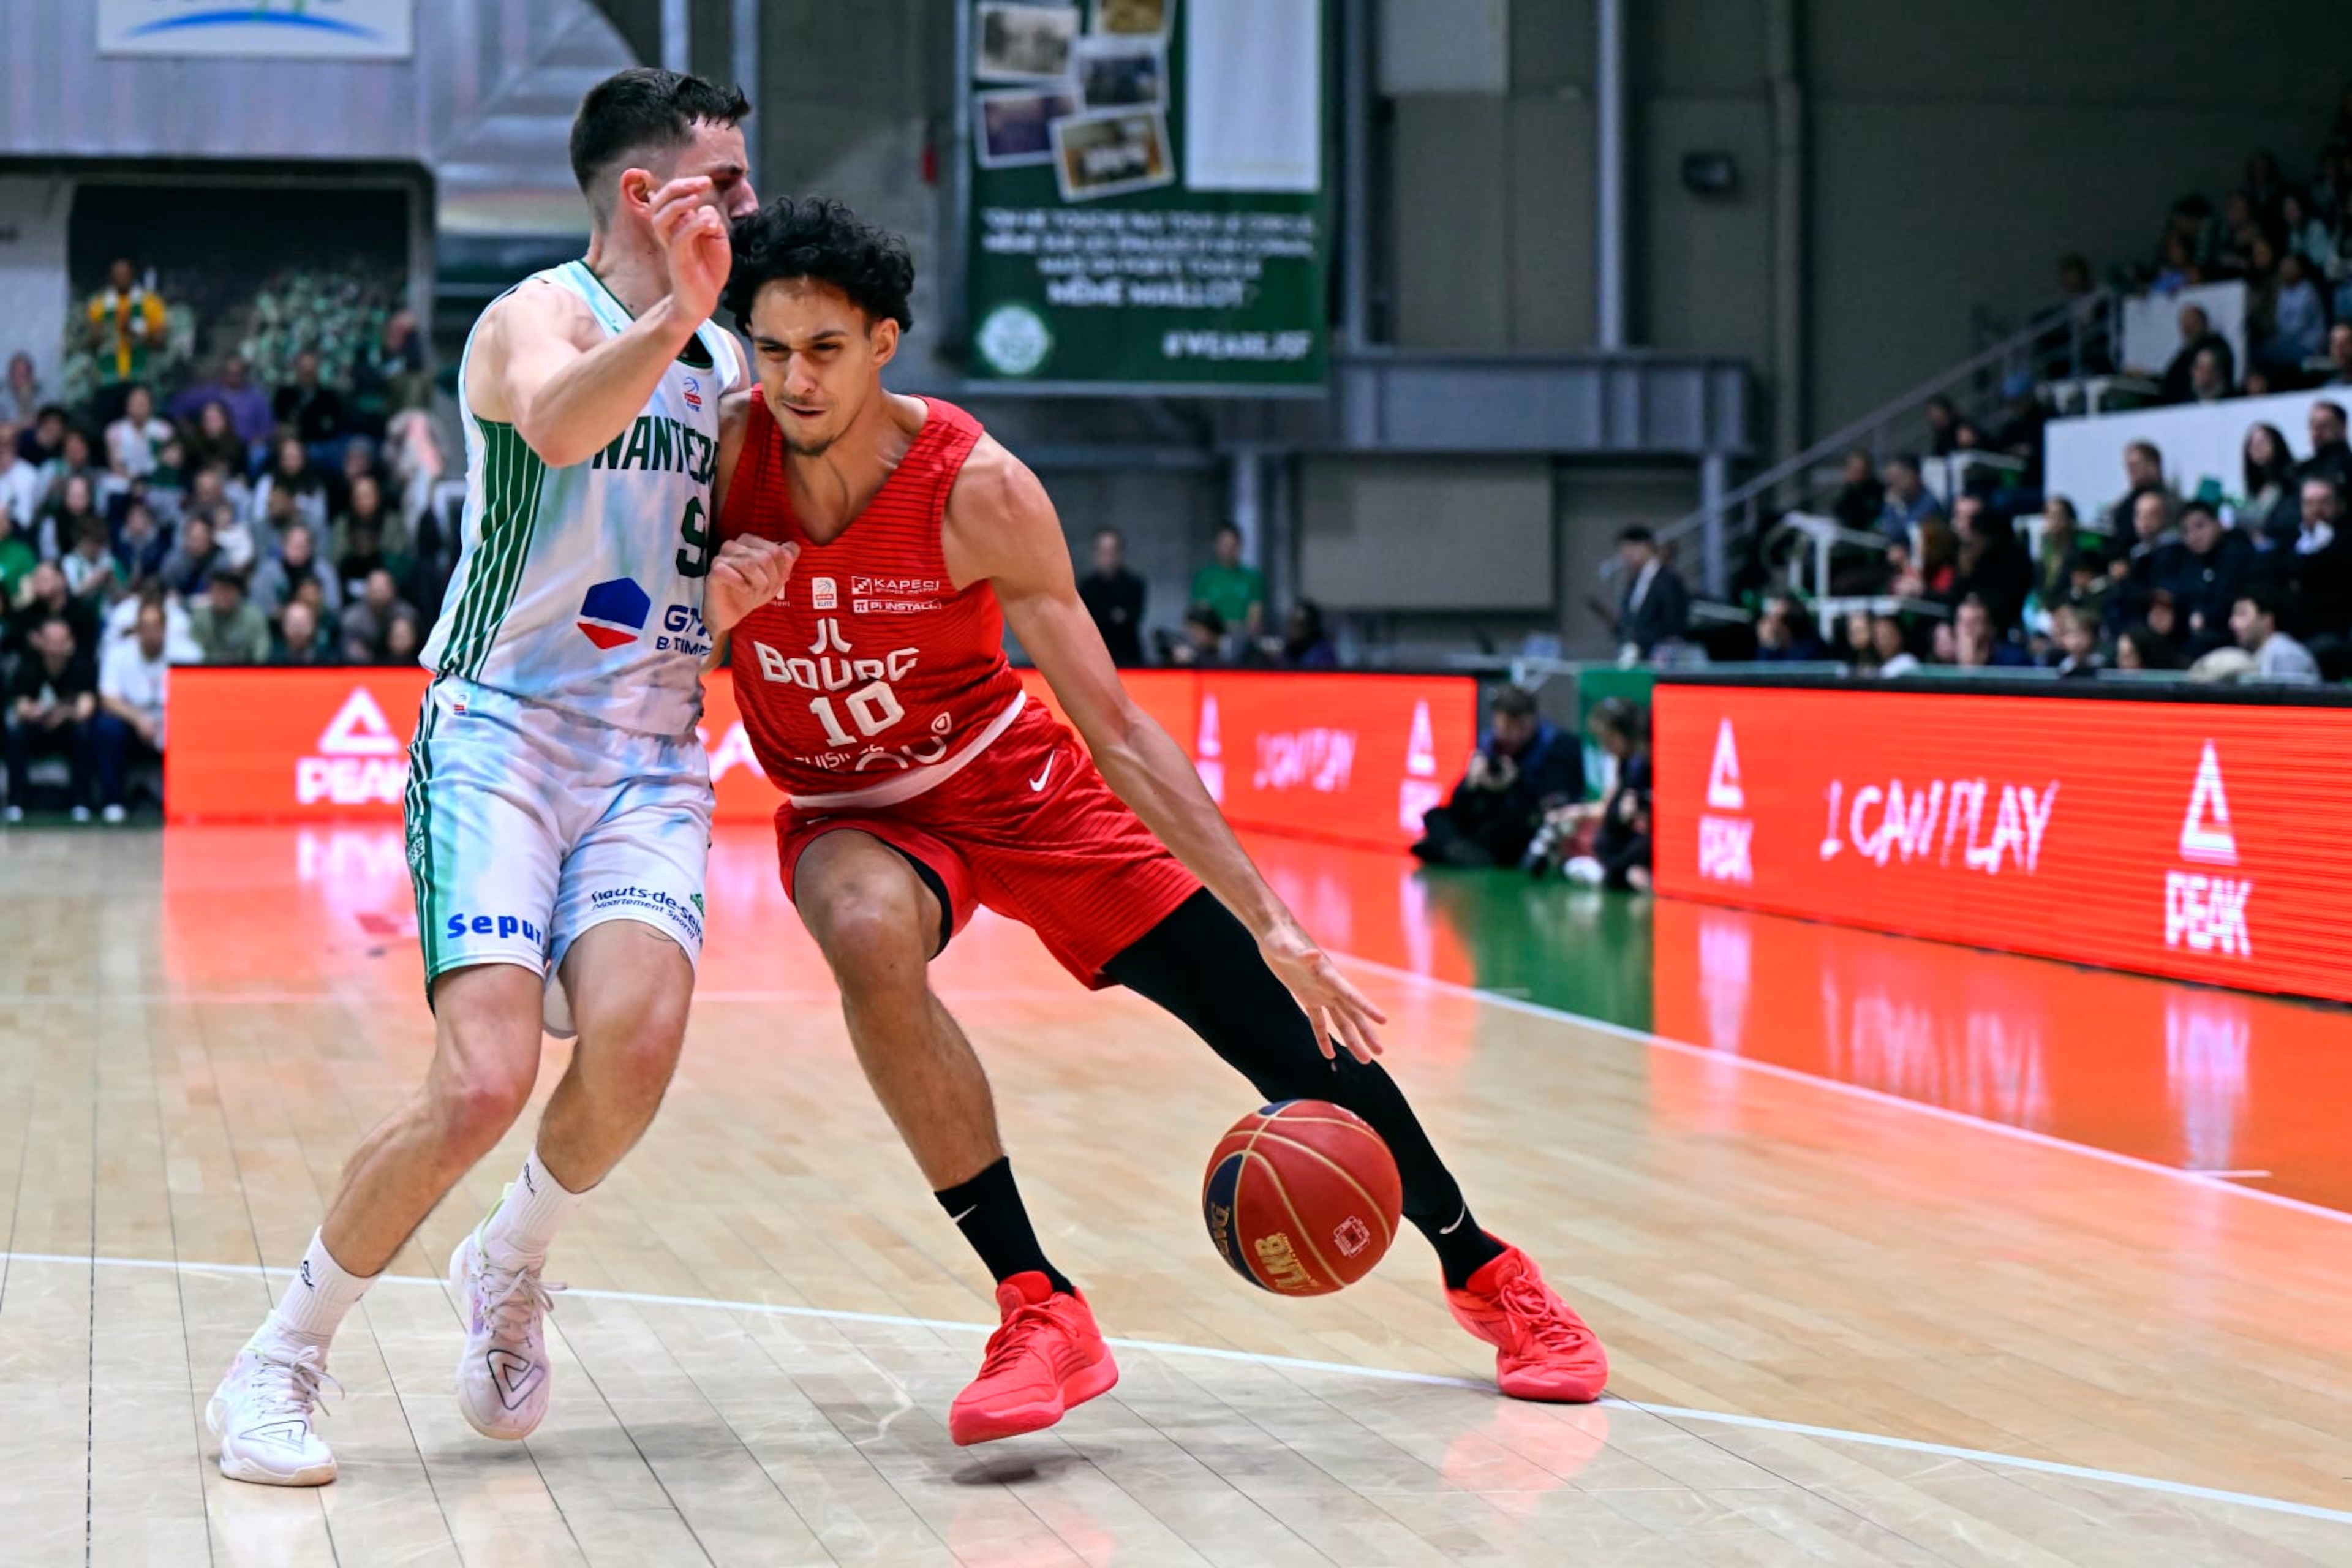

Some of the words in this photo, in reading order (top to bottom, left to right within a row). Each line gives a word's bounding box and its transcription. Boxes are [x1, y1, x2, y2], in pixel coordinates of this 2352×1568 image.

[754, 641, 920, 692] BOURG
[809, 680, 905, 747] 10
[1849, 778, 1945, 869] CAN
[1940, 777, 2061, 877] PLAY
[2165, 870, 2255, 960] PEAK
